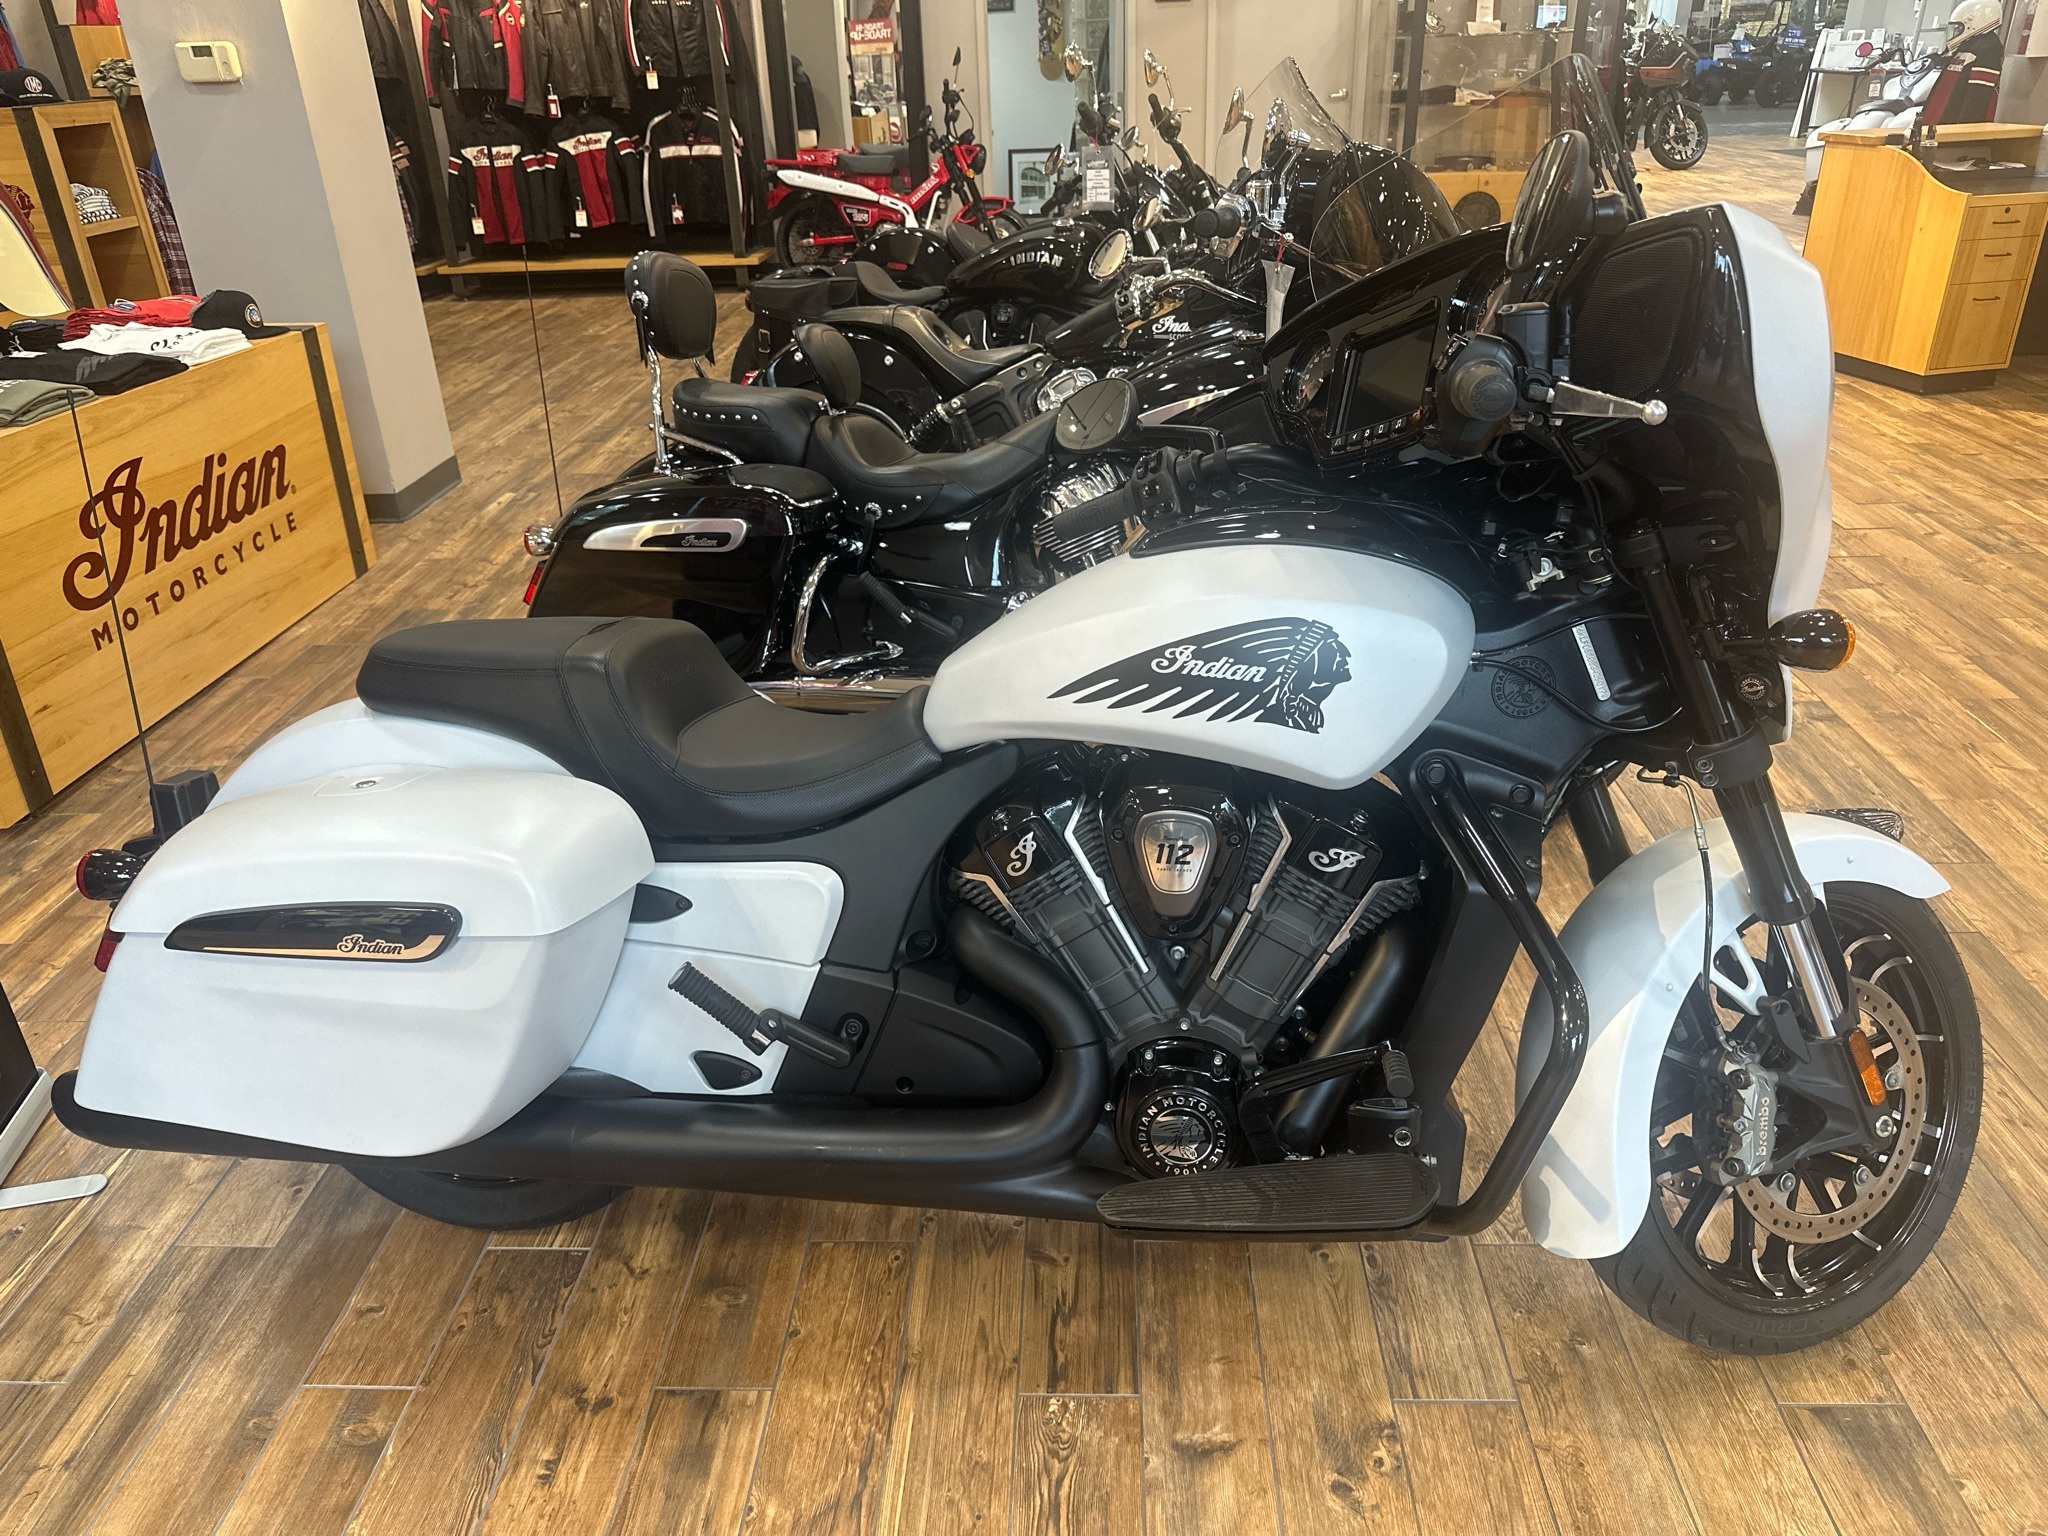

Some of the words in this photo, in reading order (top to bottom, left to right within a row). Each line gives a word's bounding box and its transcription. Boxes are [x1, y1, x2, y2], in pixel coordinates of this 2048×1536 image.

[1010, 251, 1063, 268] INDIAN
[62, 443, 290, 611] Indian
[681, 535, 718, 547] Indian
[91, 511, 297, 651] MOTORCYCLE
[1151, 645, 1267, 682] Indian
[1155, 843, 1195, 866] 112
[337, 935, 404, 955] Indian
[1138, 1105, 1158, 1159] INDIAN
[1162, 1096, 1227, 1164] MOTORCYCLE
[1756, 1096, 1769, 1156] brembo
[1165, 1166, 1198, 1176] 1901
